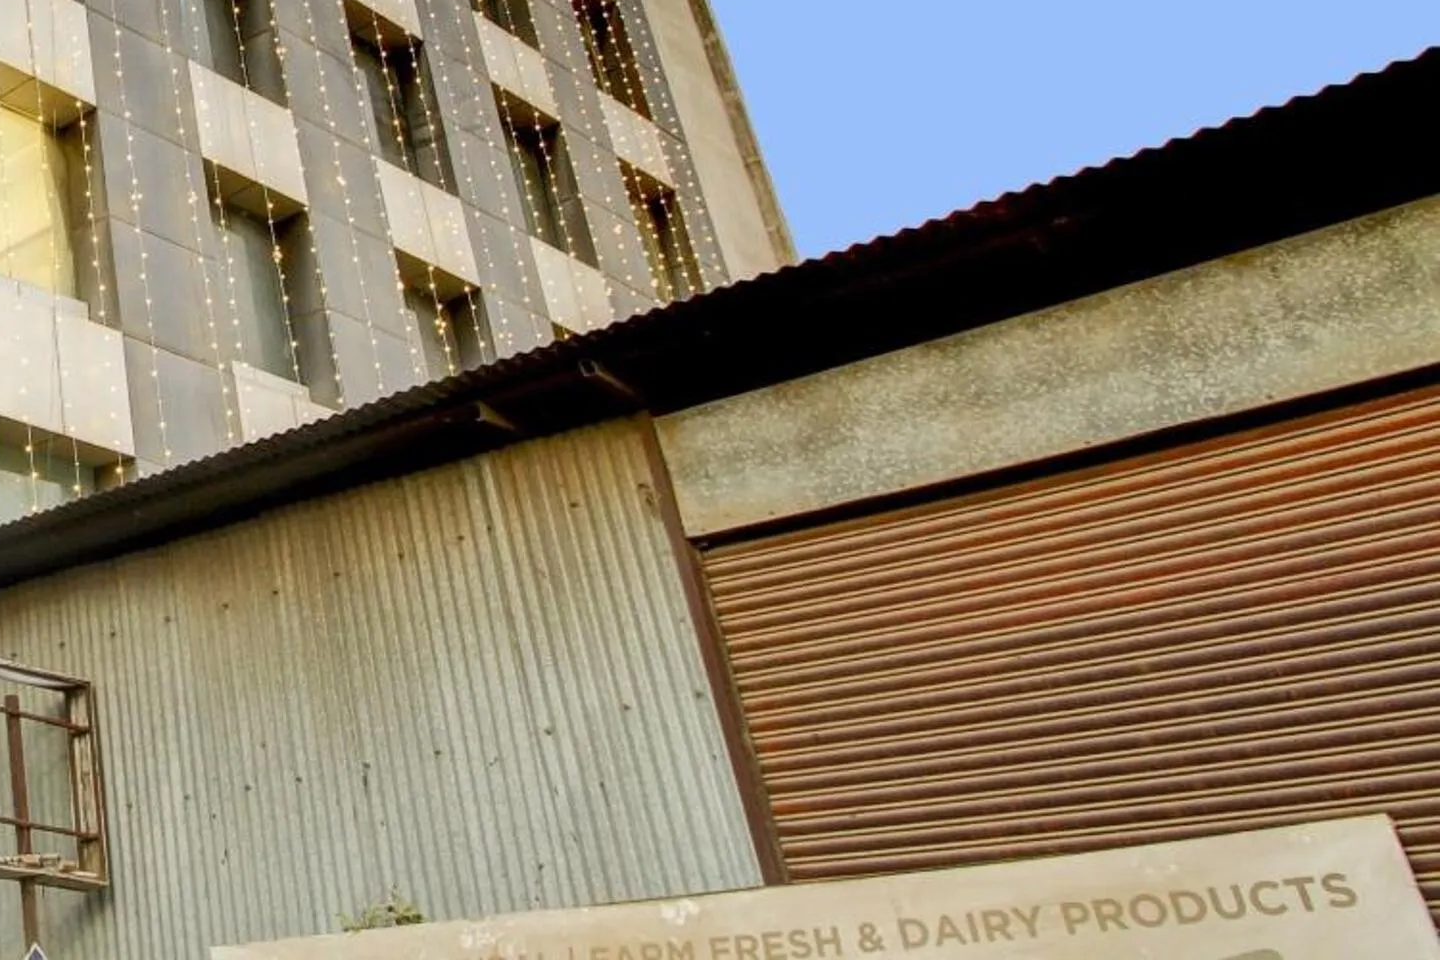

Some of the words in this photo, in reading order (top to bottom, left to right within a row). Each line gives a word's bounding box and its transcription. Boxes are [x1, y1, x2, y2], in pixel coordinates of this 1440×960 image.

[709, 925, 843, 960] FRESH
[857, 922, 886, 953] &
[898, 905, 1042, 951] DAIRY
[1060, 872, 1358, 936] PRODUCTS
